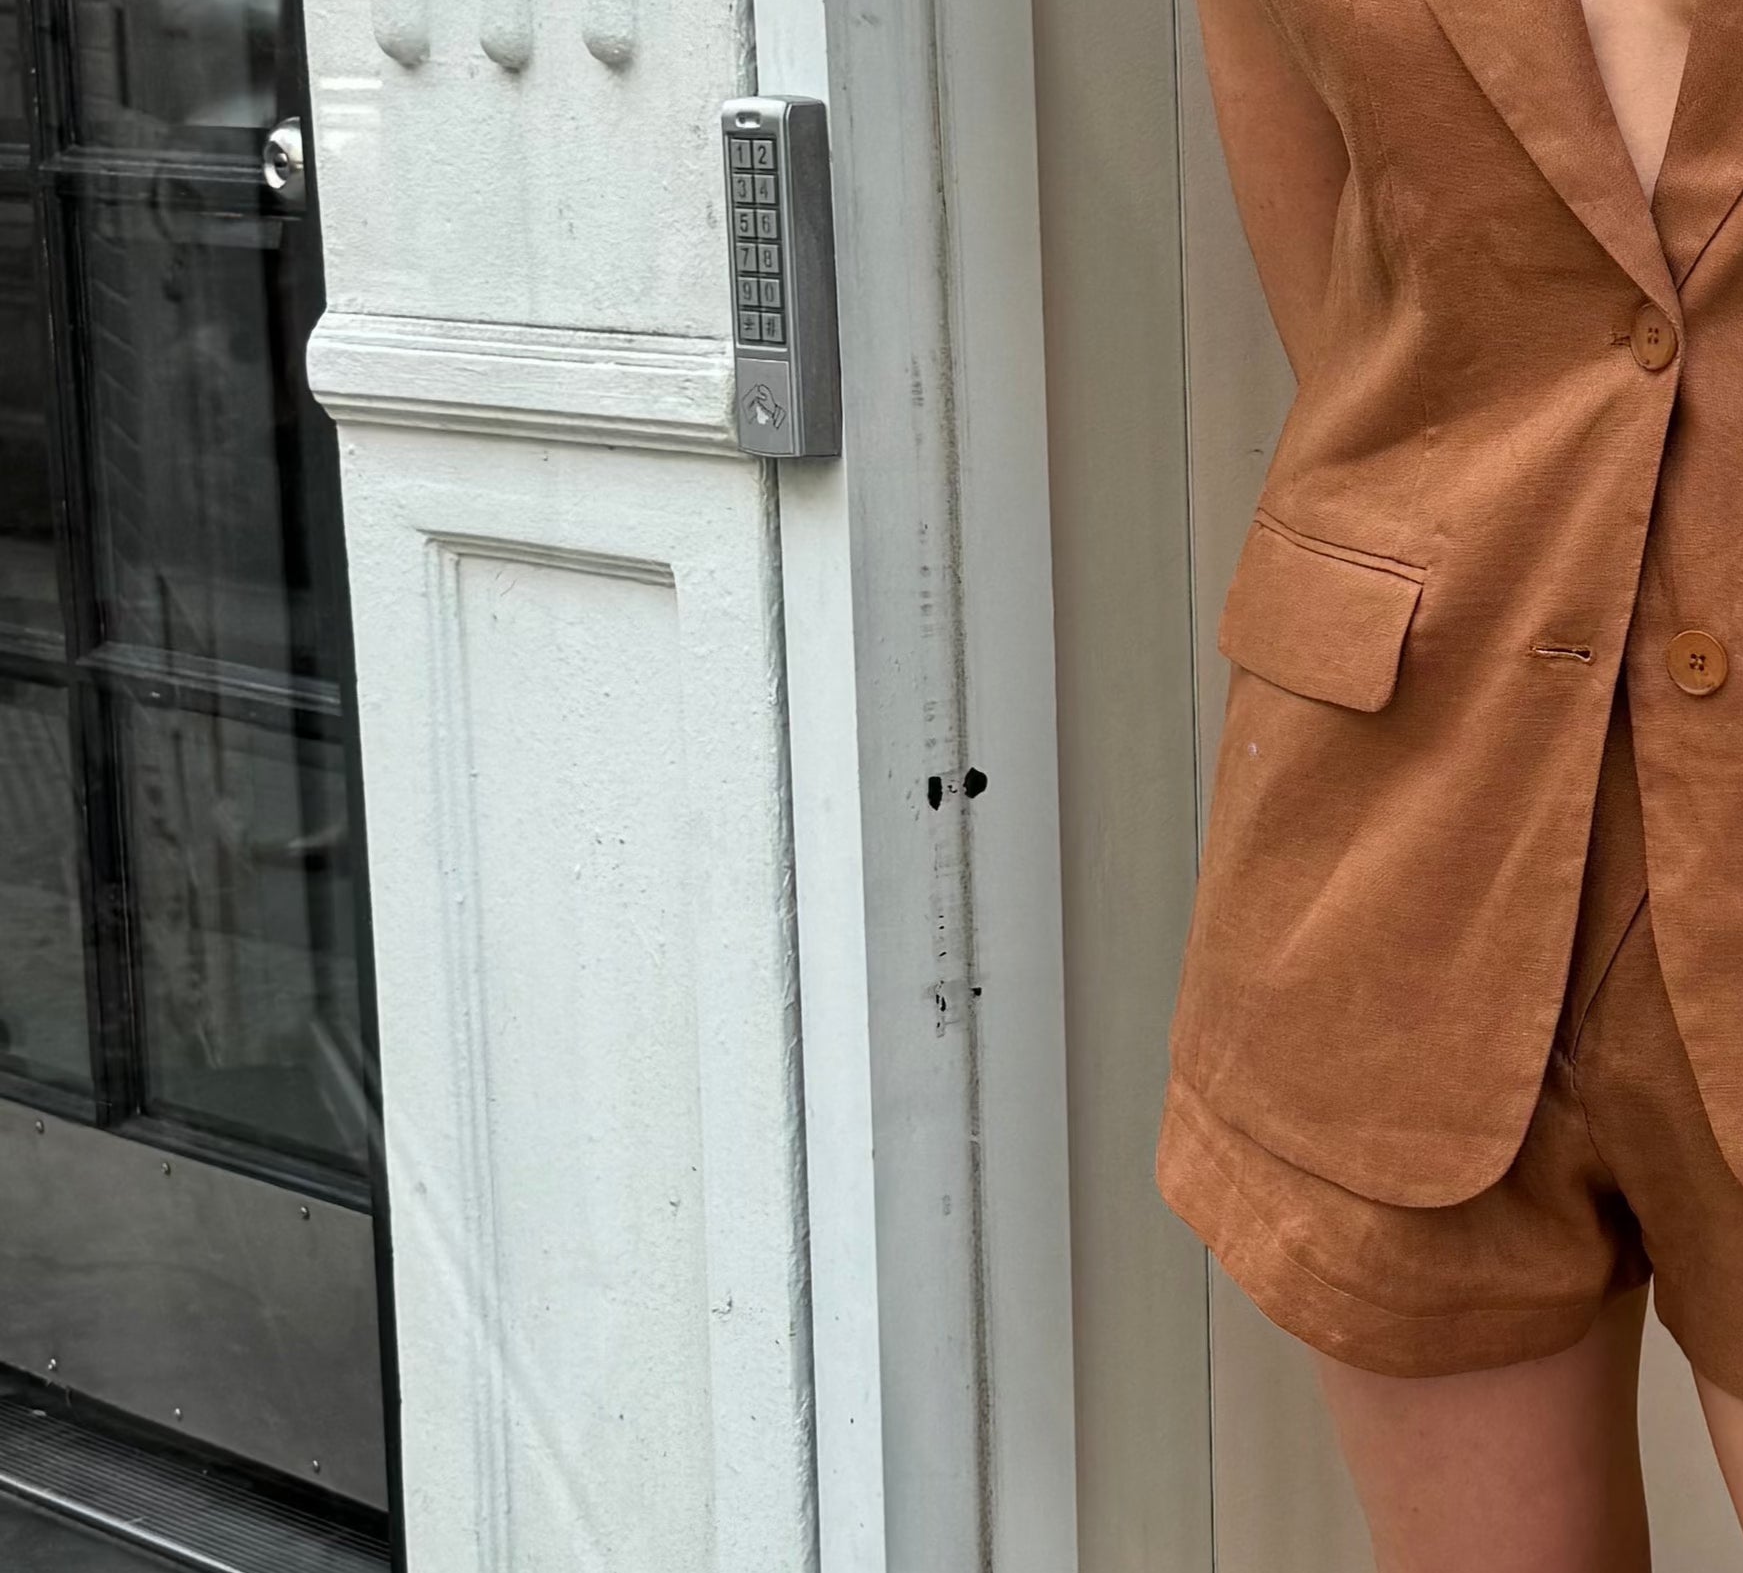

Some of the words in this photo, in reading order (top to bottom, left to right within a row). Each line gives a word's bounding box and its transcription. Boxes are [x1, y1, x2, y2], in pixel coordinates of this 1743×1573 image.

[758, 145, 767, 165] 2
[737, 179, 746, 198] 3
[760, 179, 768, 200] 4
[740, 213, 748, 232] 5
[762, 215, 770, 233] 6
[740, 247, 749, 267] 7
[764, 250, 772, 268] 8
[742, 282, 752, 300] 9
[764, 282, 774, 302] 0
